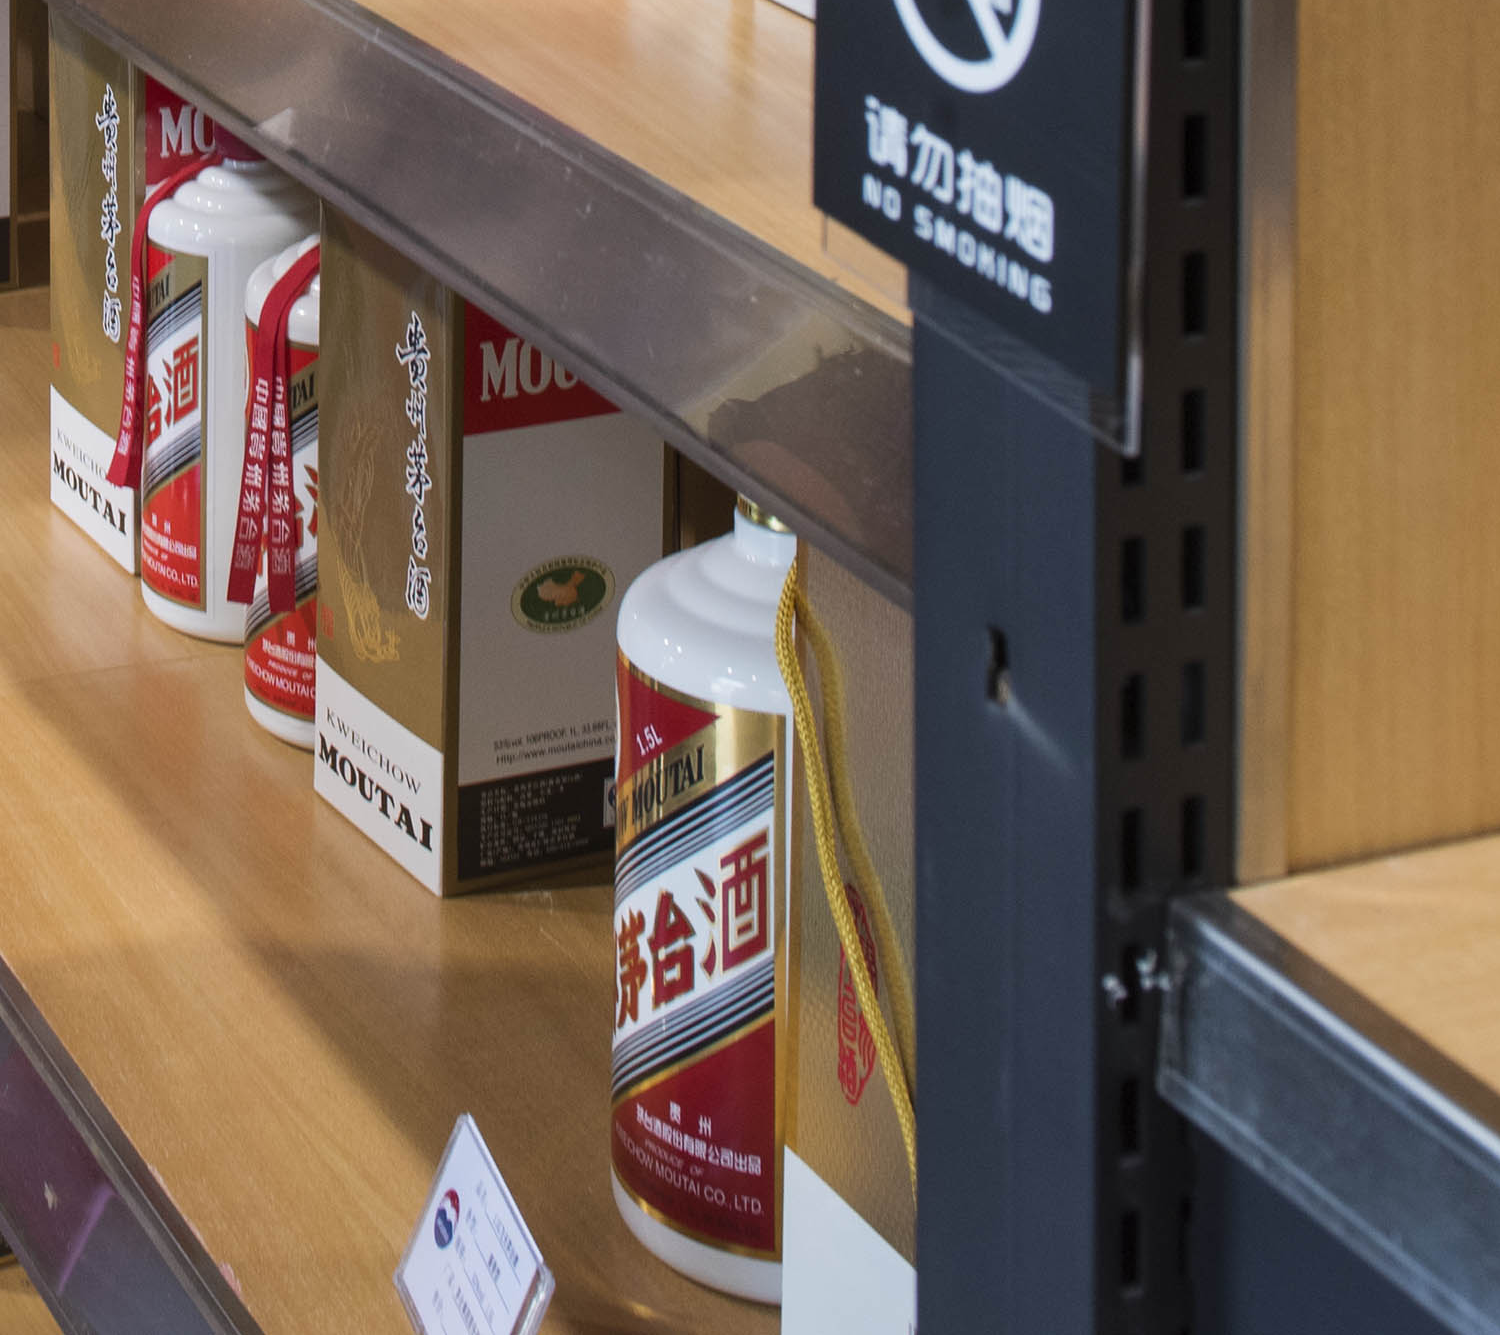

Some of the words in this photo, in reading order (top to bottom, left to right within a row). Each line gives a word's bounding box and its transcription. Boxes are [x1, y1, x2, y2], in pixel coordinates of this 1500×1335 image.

[864, 93, 1054, 264] 请勿抽烟
[862, 172, 902, 222] NO
[913, 203, 1053, 315] SMOKING
[52, 449, 128, 537] MOUTAI
[326, 705, 421, 797] KWEICHOW
[631, 743, 706, 820] MOUTAI
[635, 723, 663, 758] 1.5L
[318, 731, 434, 854] MOUTAI
[655, 1160, 700, 1199] MOUTAI
